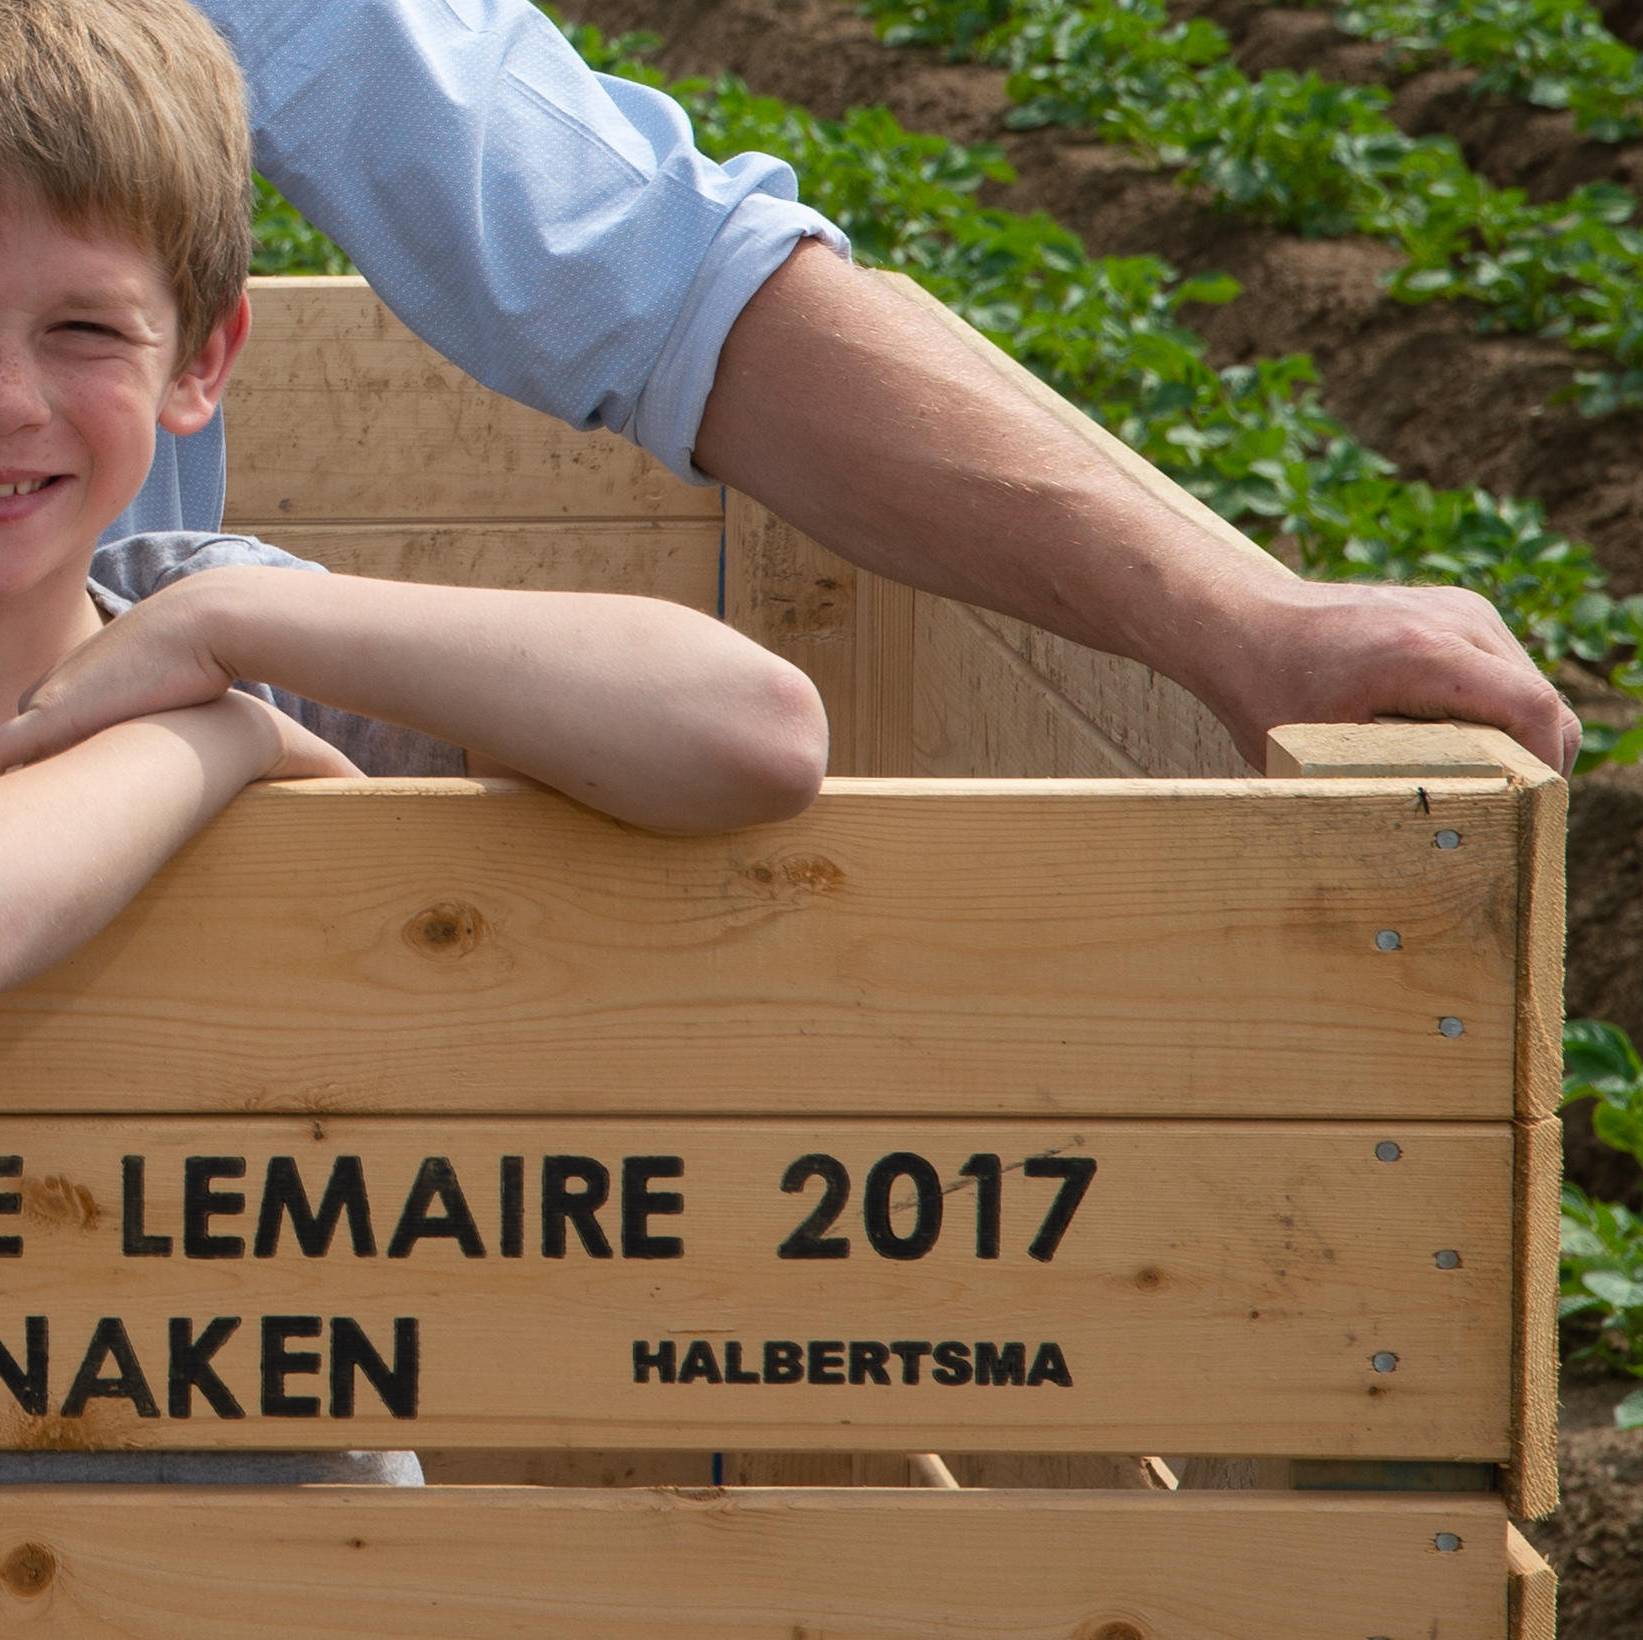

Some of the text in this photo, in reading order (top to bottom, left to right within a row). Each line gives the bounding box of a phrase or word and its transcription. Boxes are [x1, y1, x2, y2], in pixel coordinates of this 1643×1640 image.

[121, 1153, 686, 1262] LEMAIRE
[776, 1151, 1099, 1263] 2017
[632, 1340, 1074, 1389] HALBERTSMA
